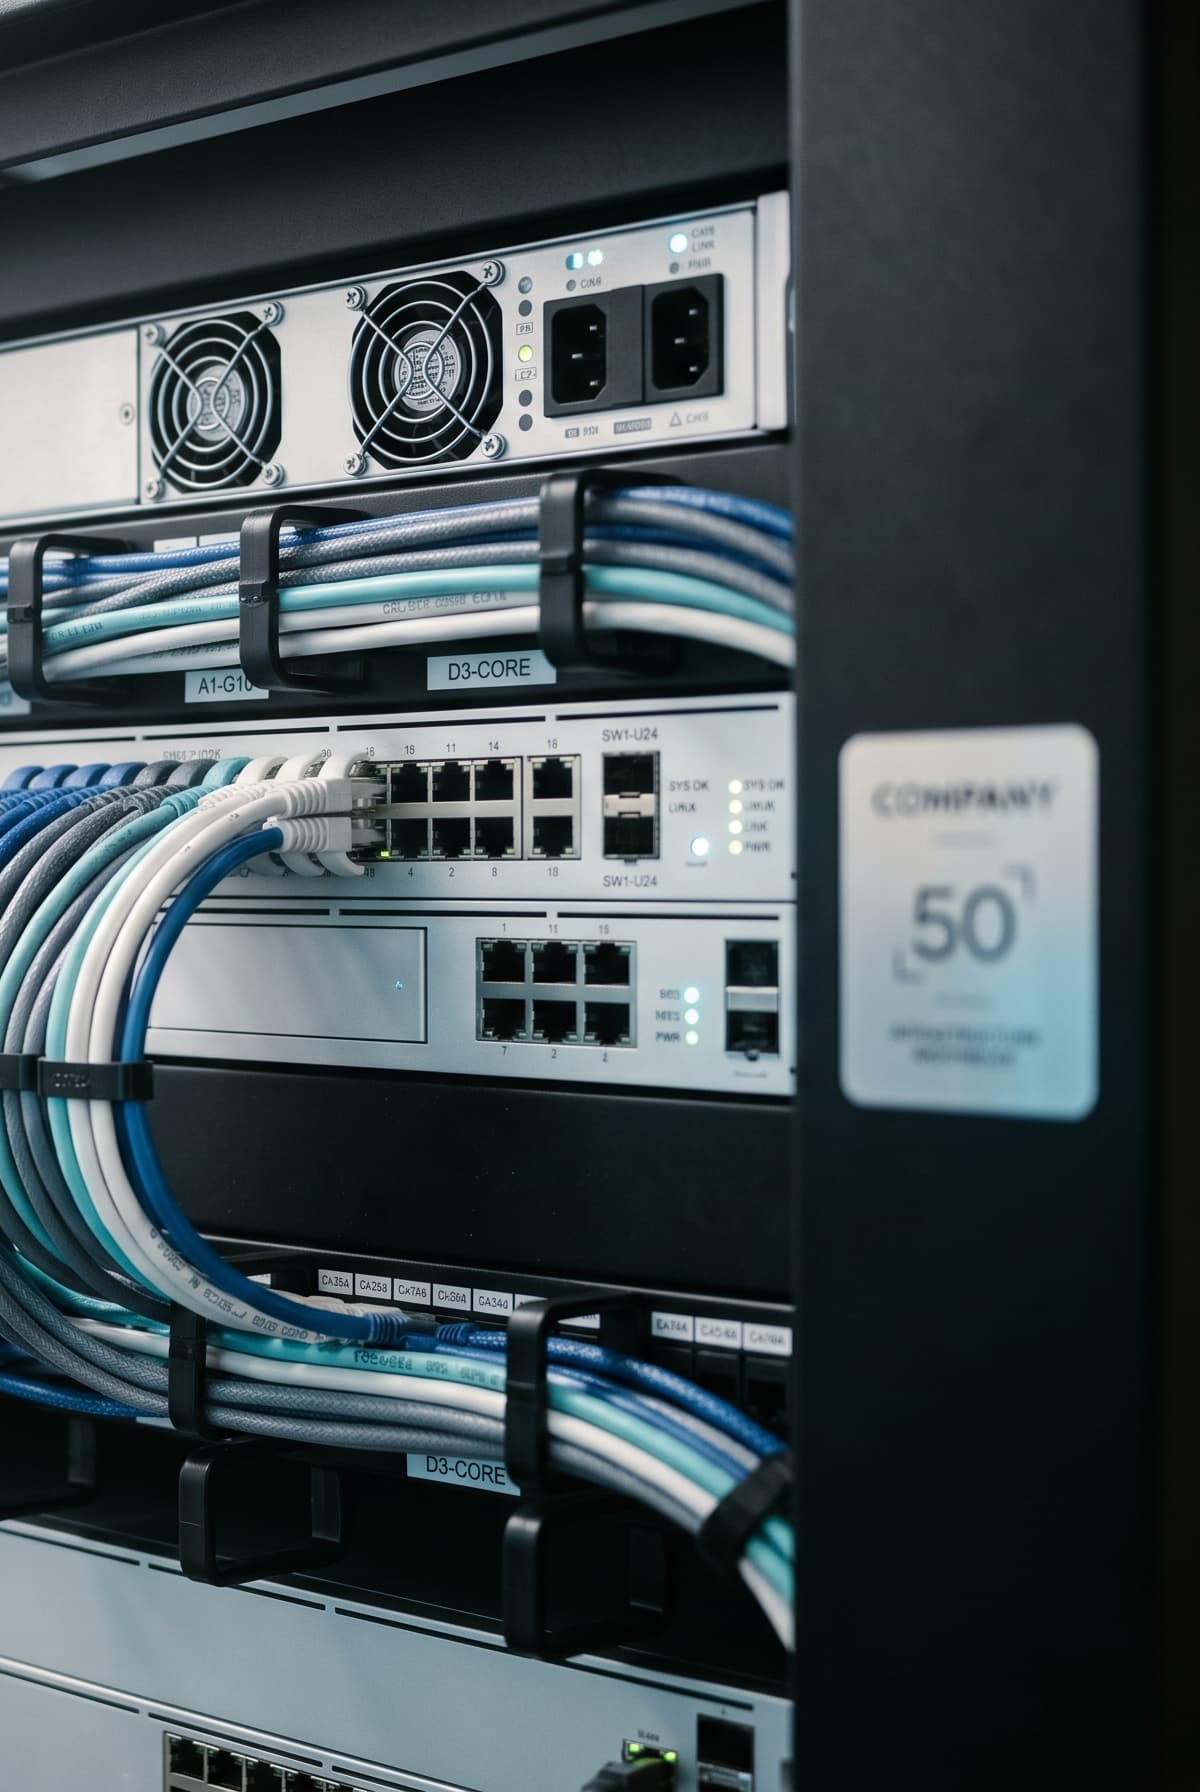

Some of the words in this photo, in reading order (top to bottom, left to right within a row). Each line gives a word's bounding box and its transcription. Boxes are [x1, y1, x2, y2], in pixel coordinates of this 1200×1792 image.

[448, 658, 531, 681] D3-CORE
[601, 727, 659, 742] SW1-U24
[488, 740, 499, 751] 14
[448, 867, 455, 877] 2
[603, 874, 658, 888] SW1-U24
[911, 885, 1018, 964] 50
[321, 1274, 350, 1289] CA35A
[426, 1455, 506, 1486] D3-CORE
